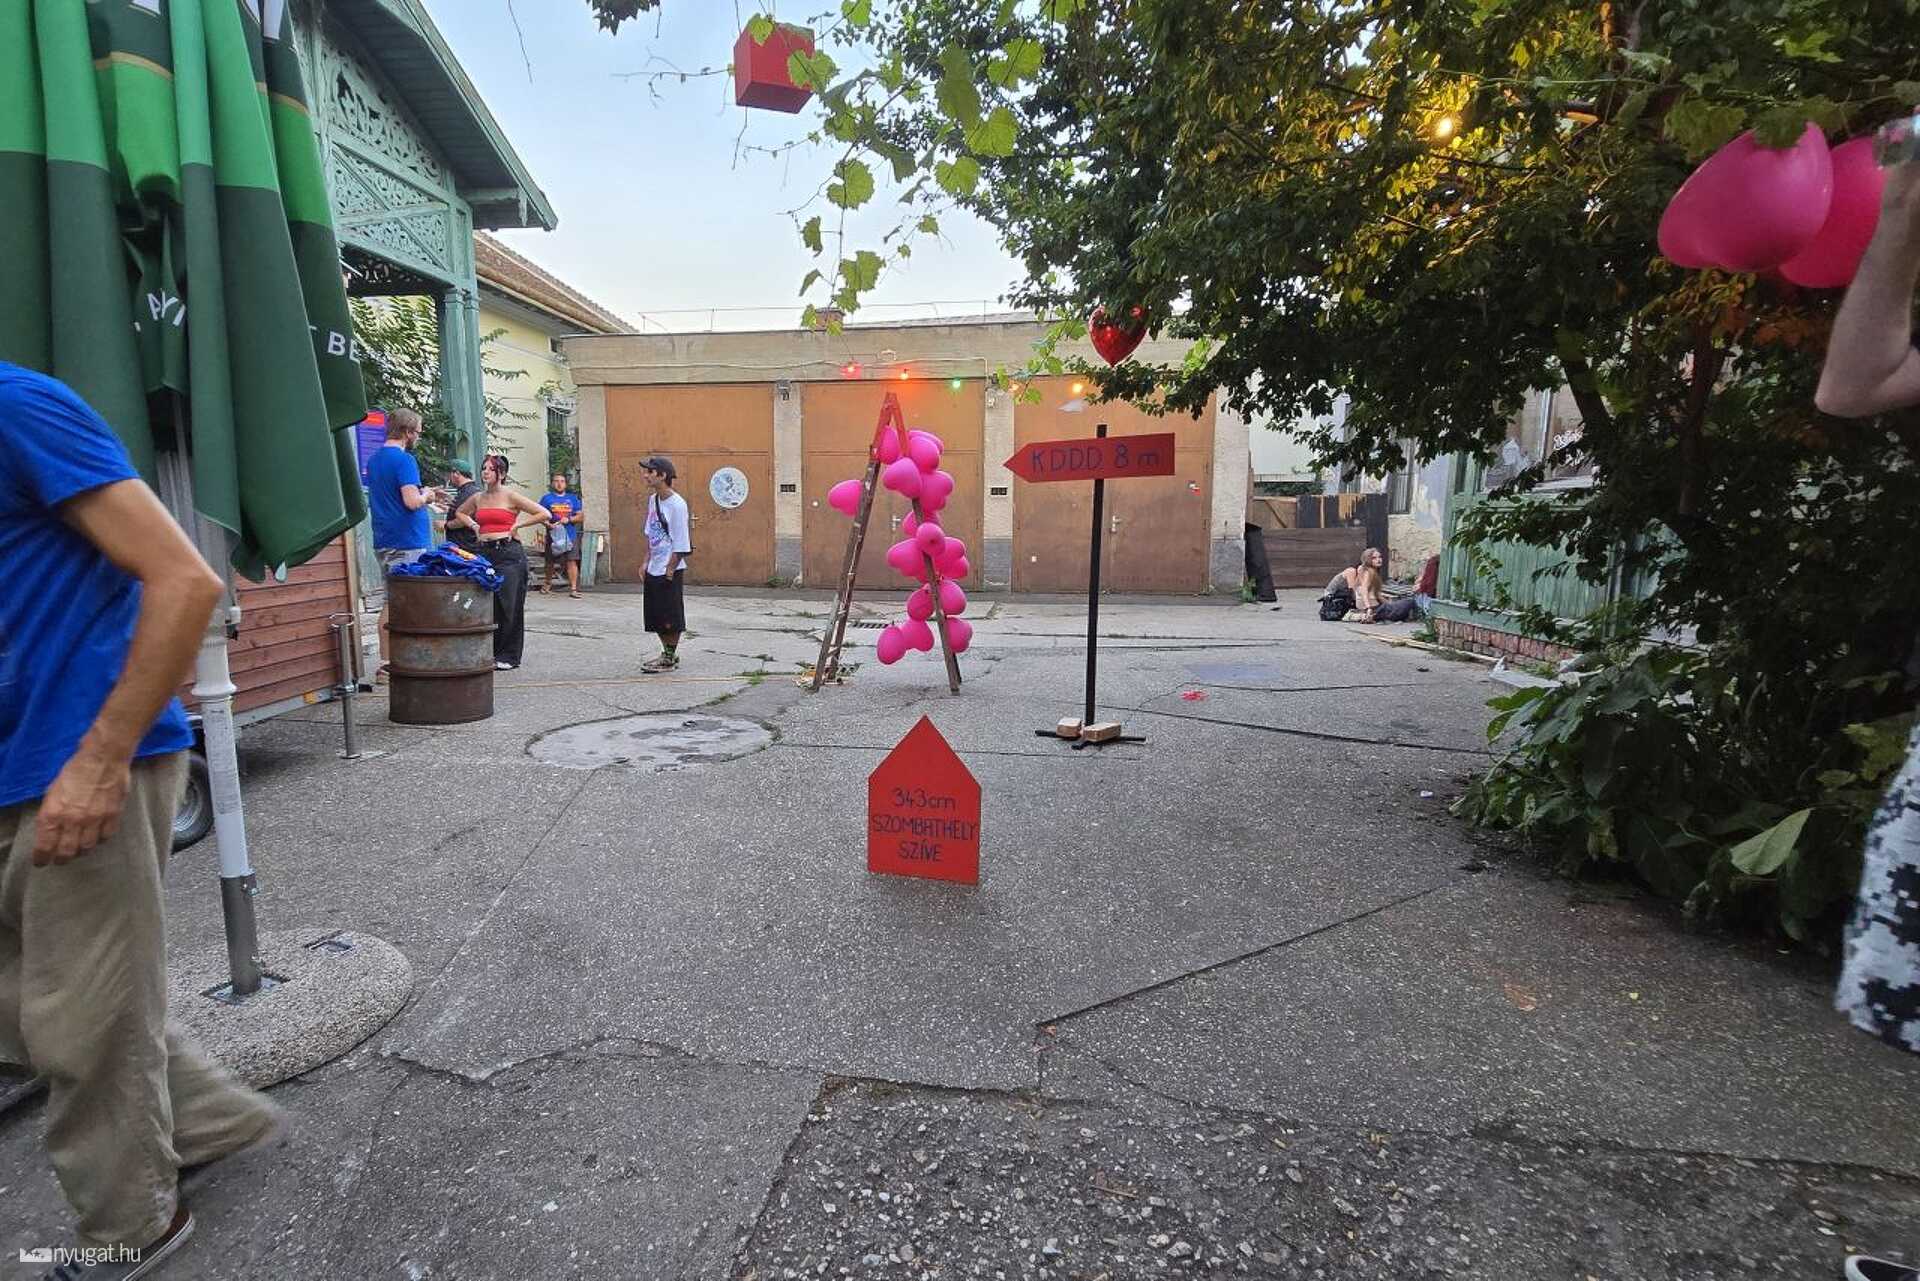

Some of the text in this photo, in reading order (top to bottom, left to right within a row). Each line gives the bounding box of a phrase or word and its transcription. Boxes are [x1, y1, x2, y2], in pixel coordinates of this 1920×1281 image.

[1032, 446, 1105, 473] KDDD
[1114, 442, 1130, 469] 8
[872, 814, 977, 841] SZOMBATHELY
[899, 838, 942, 862] SZÍVE
